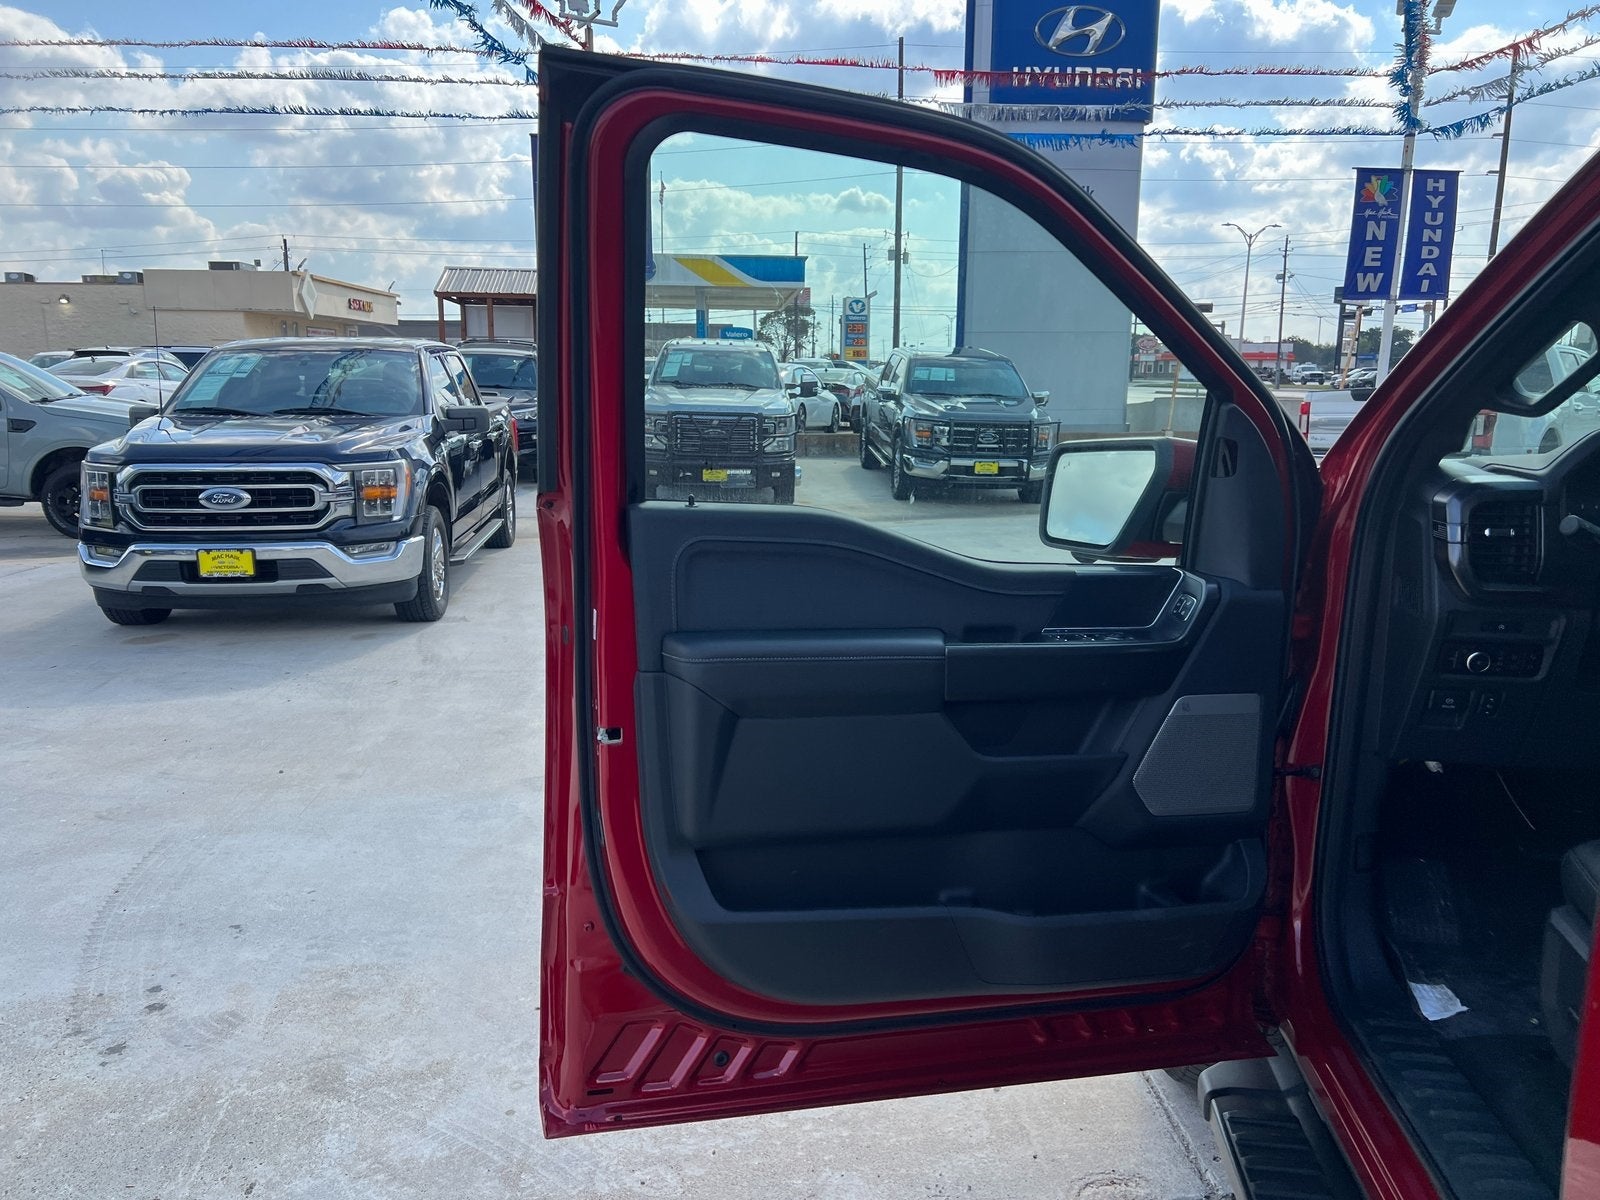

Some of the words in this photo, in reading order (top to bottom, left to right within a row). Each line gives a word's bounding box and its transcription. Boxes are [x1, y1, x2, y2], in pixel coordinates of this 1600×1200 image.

[1012, 66, 1142, 88] HYUNDAI
[1356, 220, 1387, 292] NEW
[1417, 178, 1446, 293] HYUNDAI
[211, 493, 236, 504] Ford
